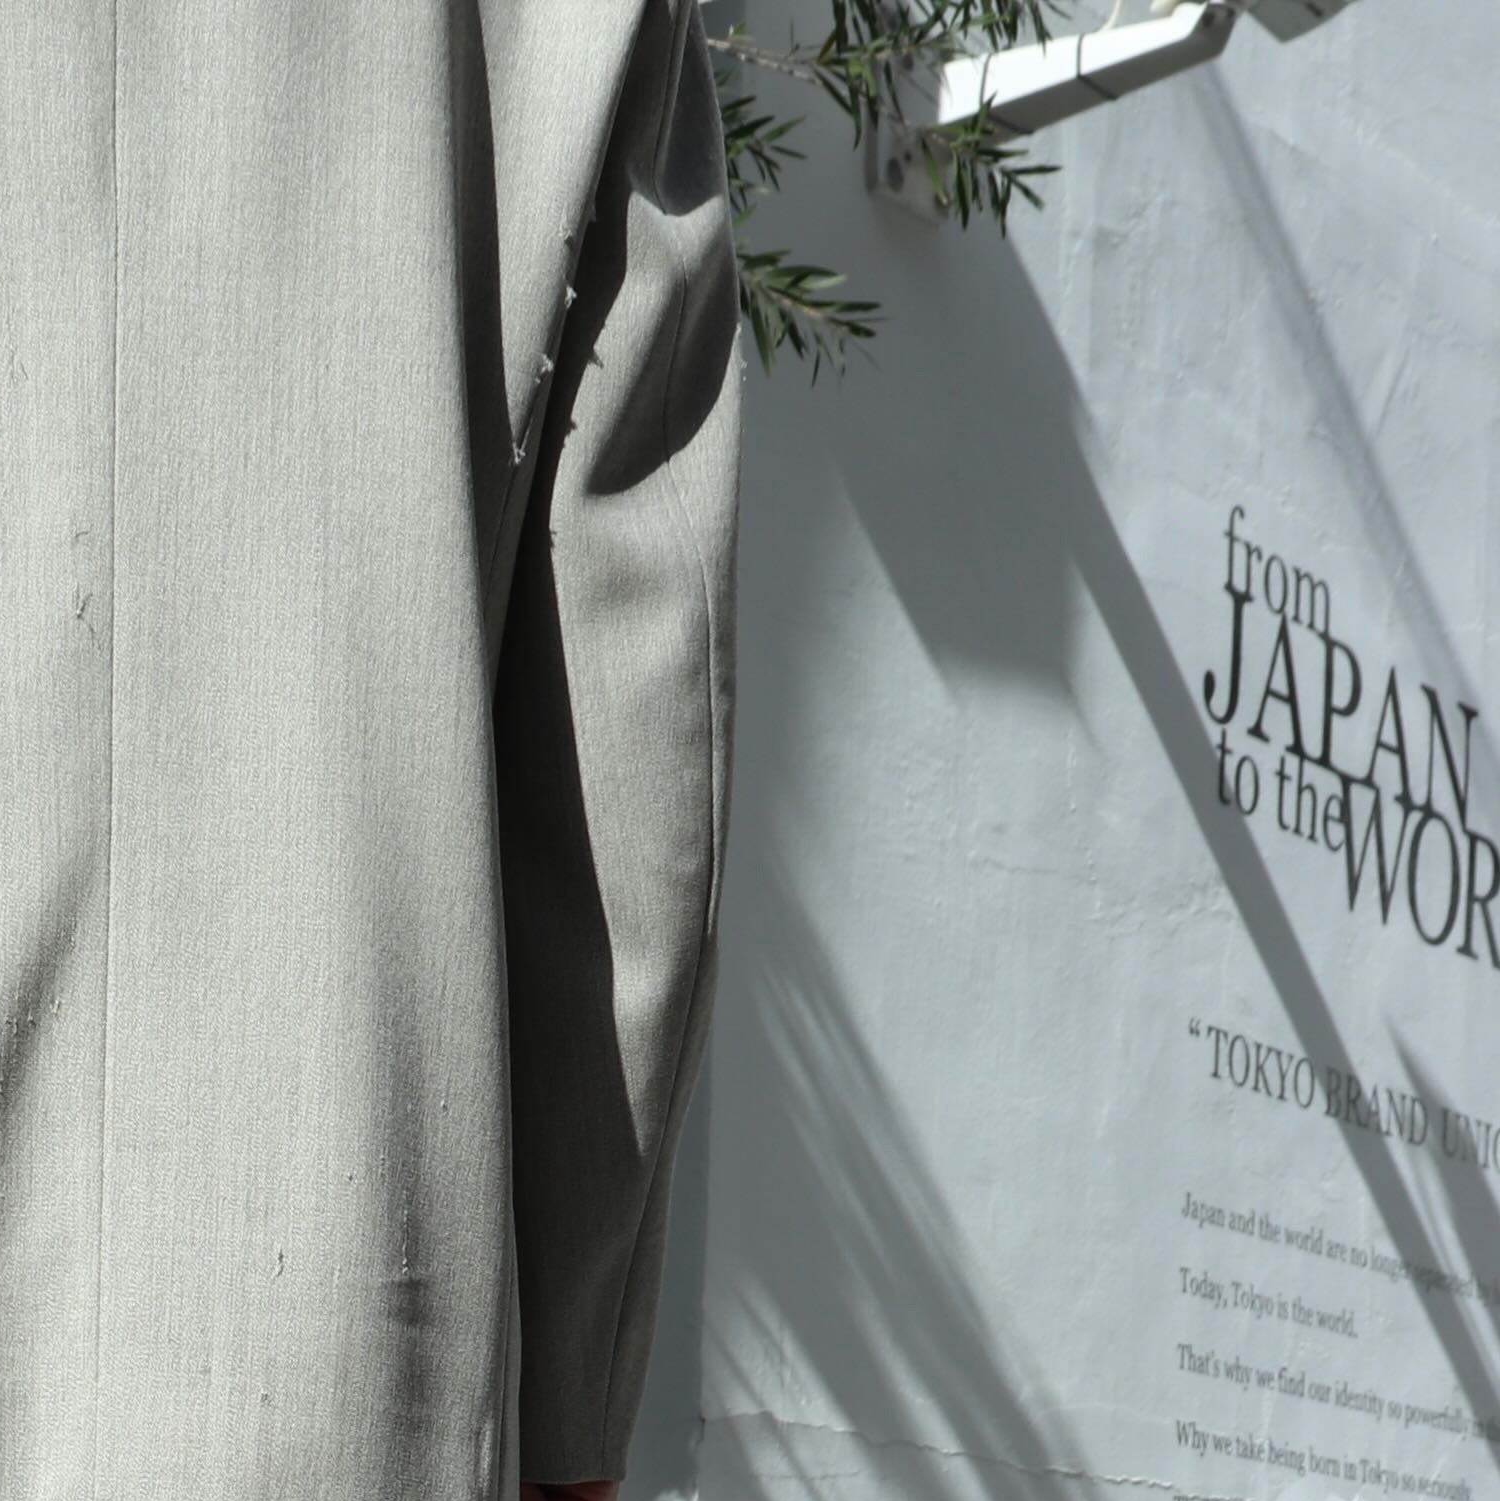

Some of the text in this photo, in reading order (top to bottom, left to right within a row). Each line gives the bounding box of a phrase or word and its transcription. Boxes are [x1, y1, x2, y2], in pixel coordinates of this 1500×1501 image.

[1223, 505, 1333, 640] from
[1204, 592, 1479, 835] JAPAN
[1216, 728, 1260, 816] to
[1275, 755, 1349, 853] the
[1324, 1064, 1430, 1147] BRAND
[1181, 1191, 1225, 1229] Japan
[1228, 1207, 1256, 1237] and
[1259, 1211, 1281, 1243] the
[1284, 1226, 1324, 1257] world
[1326, 1240, 1348, 1263] are
[1350, 1246, 1368, 1268] no
[1179, 1266, 1359, 1338] Today, Tokyo is the world.
[1223, 1355, 1252, 1392] why
[1255, 1367, 1276, 1391] we
[1277, 1366, 1305, 1398] find
[1307, 1382, 1332, 1403] our
[1334, 1379, 1384, 1423] identity
[1386, 1400, 1403, 1420] so
[1175, 1419, 1210, 1457] Why
[1211, 1433, 1233, 1456] we
[1235, 1432, 1266, 1462] take
[1266, 1436, 1306, 1478] being
[1308, 1444, 1341, 1478] born
[1342, 1453, 1358, 1481] in
[1358, 1458, 1400, 1494] Tokyo
[1400, 1473, 1415, 1493] so
